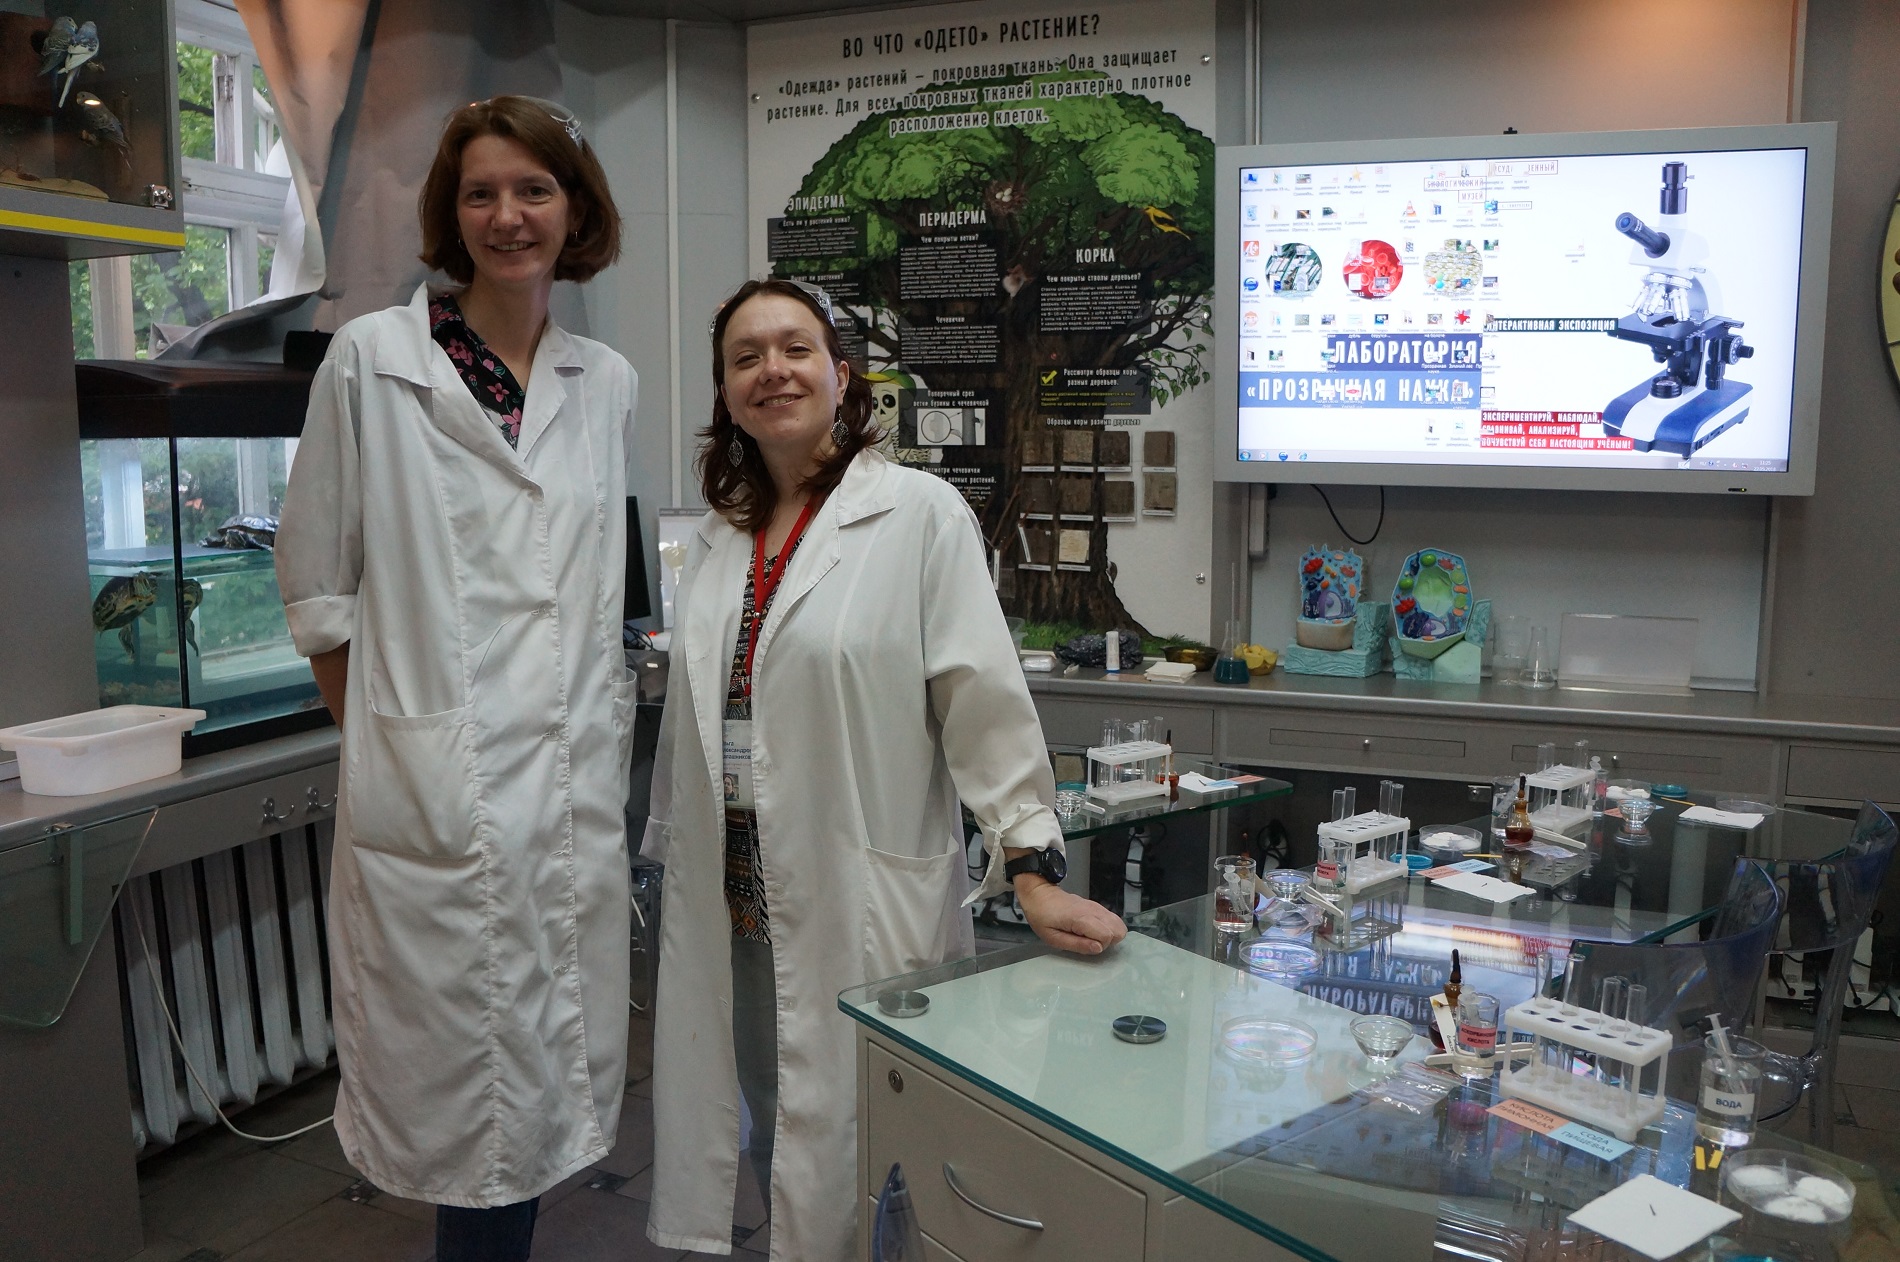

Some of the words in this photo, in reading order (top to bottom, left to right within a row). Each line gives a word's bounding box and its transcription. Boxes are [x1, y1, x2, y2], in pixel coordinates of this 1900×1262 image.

[843, 37, 863, 58] ВО
[874, 33, 903, 55] ЧТО
[915, 25, 988, 54] «ОДЕТО»
[1000, 14, 1100, 43] РАСТЕНИЕ?
[779, 80, 840, 97] «Одежда»
[847, 69, 907, 92] растений
[933, 63, 1005, 84] покровная
[1068, 54, 1094, 71] Она
[1103, 50, 1177, 69] защищает
[767, 103, 828, 124] растение.
[836, 99, 859, 117] Для
[867, 97, 896, 111] всех
[904, 90, 977, 110] покровных
[984, 82, 1033, 101] тканей
[1040, 79, 1122, 99] характерно
[1132, 74, 1191, 91] плотное
[891, 112, 987, 136] расположение
[996, 109, 1049, 125] клеток.
[1461, 190, 1484, 200] МУЗЕЙ
[788, 194, 845, 212] ЭПИДЕРМА
[919, 210, 987, 228] ПЕРИДЕРМА
[1076, 247, 1115, 264] КОРКА
[1046, 275, 1058, 283] Чем
[1060, 275, 1085, 283] покрыты
[1087, 274, 1108, 282] стволы
[1110, 272, 1141, 282] деревьев?
[1558, 319, 1616, 332] ЭКСПОЗИЦИЯ
[1335, 340, 1477, 364] ЛАБОРАТОРИЯ
[1063, 368, 1094, 377] Рассмотри
[1096, 368, 1120, 376] образцы
[1067, 379, 1088, 387] разных
[1046, 418, 1071, 426] Образцы
[1482, 411, 1555, 423] ЭКСПЕРИМЕНТИРУЙ,
[1557, 412, 1600, 424] НАБЛЮДАЙ,
[1528, 424, 1578, 436] АНАЛИЗИРУЙ,
[1481, 437, 1526, 448] ПОЧУВСТВУЙ
[1528, 438, 1546, 447] СЕБЯ
[1550, 438, 1594, 449] НАСТОЯЩИМ
[1596, 437, 1631, 449] УЧЁНЫМ!
[1715, 1097, 1742, 1109] ВОДА
[1496, 1106, 1555, 1130] ЛИМОННАЯ
[1510, 1103, 1554, 1123] КИСЛОТА
[1561, 1130, 1613, 1154] ПИЩЕВАЯ
[1580, 1131, 1609, 1145] СОДА
